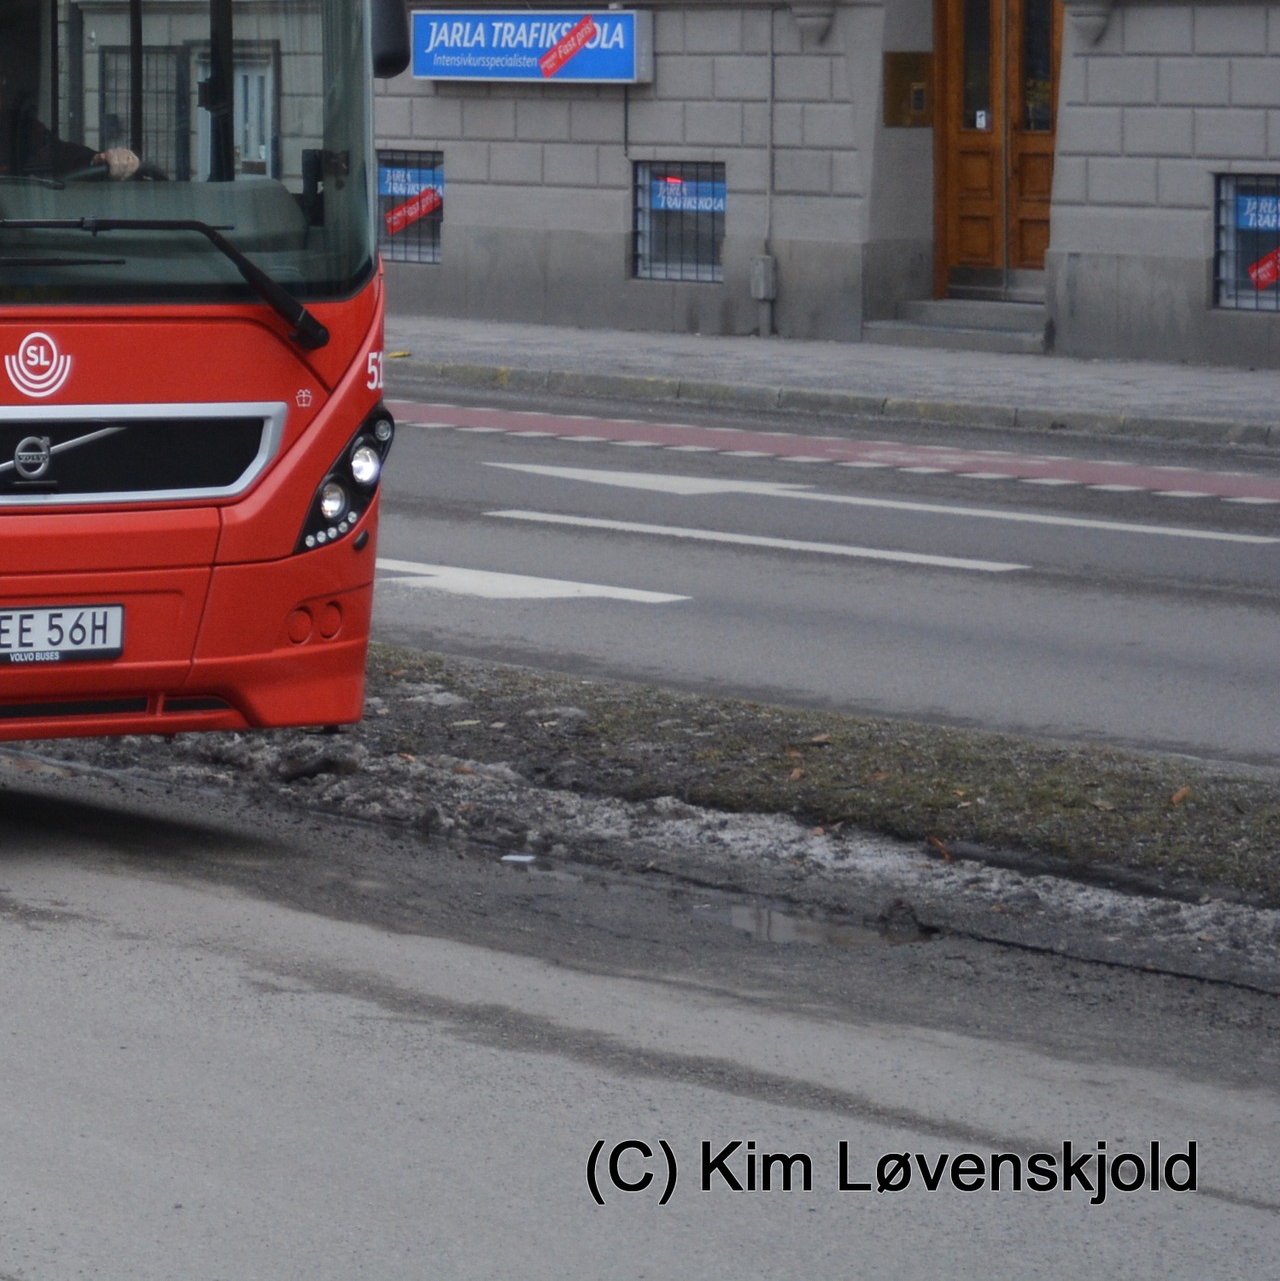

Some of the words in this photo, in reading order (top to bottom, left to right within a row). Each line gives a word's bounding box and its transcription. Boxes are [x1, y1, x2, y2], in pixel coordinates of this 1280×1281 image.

[425, 22, 485, 53] JARLA
[491, 22, 624, 49] TRAFIKSOLA
[433, 53, 537, 70] Intensivkursspecialisten
[26, 345, 50, 366] SL
[47, 611, 108, 647] 56H
[9, 652, 35, 662] VOLVO
[35, 651, 60, 662] BUSES
